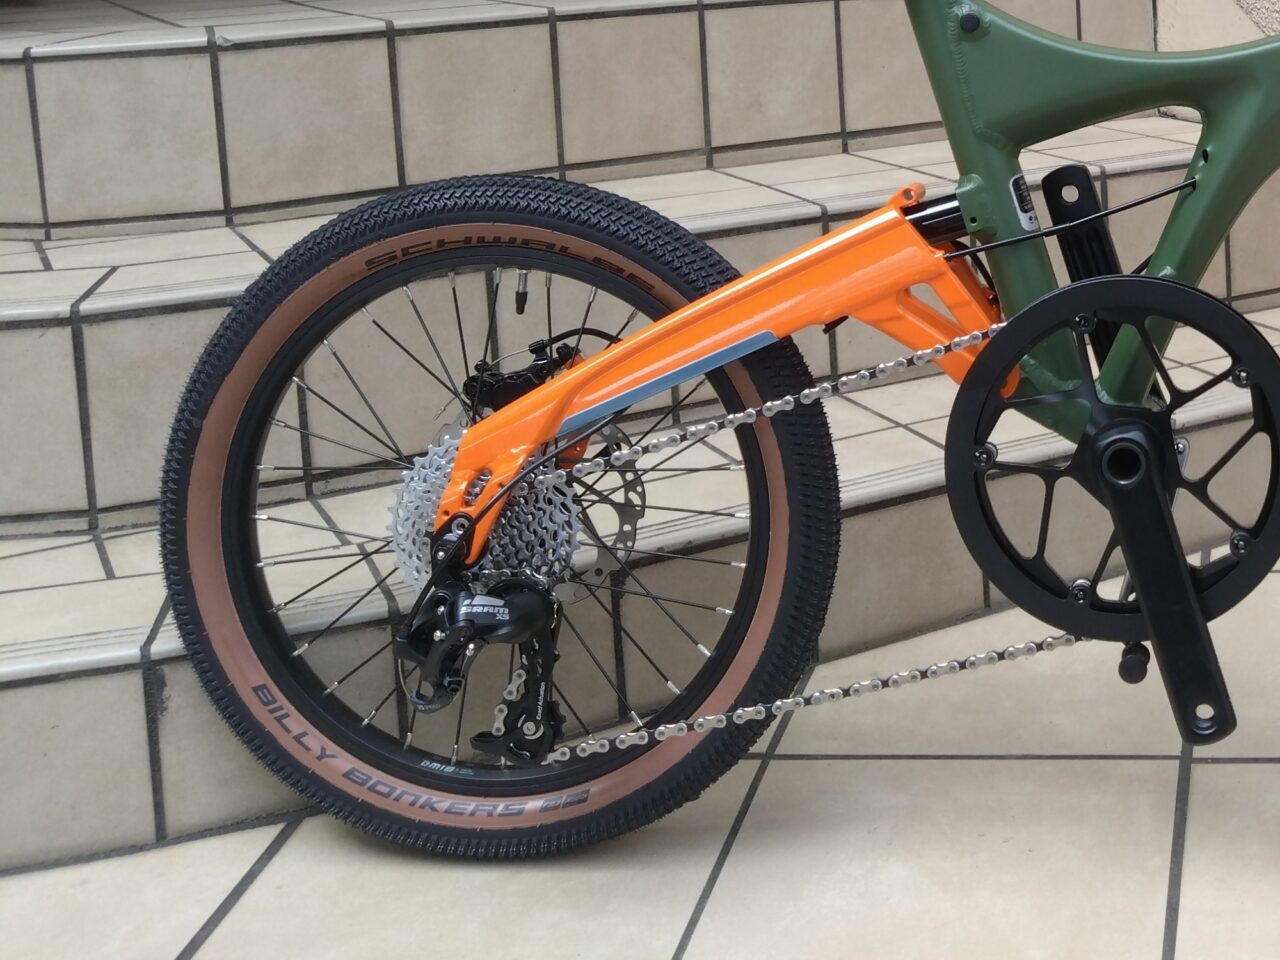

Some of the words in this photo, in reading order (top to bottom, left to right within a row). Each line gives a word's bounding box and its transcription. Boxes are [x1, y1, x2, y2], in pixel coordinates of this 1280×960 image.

[364, 235, 655, 290] SCHWALBE
[459, 605, 509, 614] SRAM
[251, 683, 338, 762] BILLY
[342, 766, 528, 816] BONKERS
